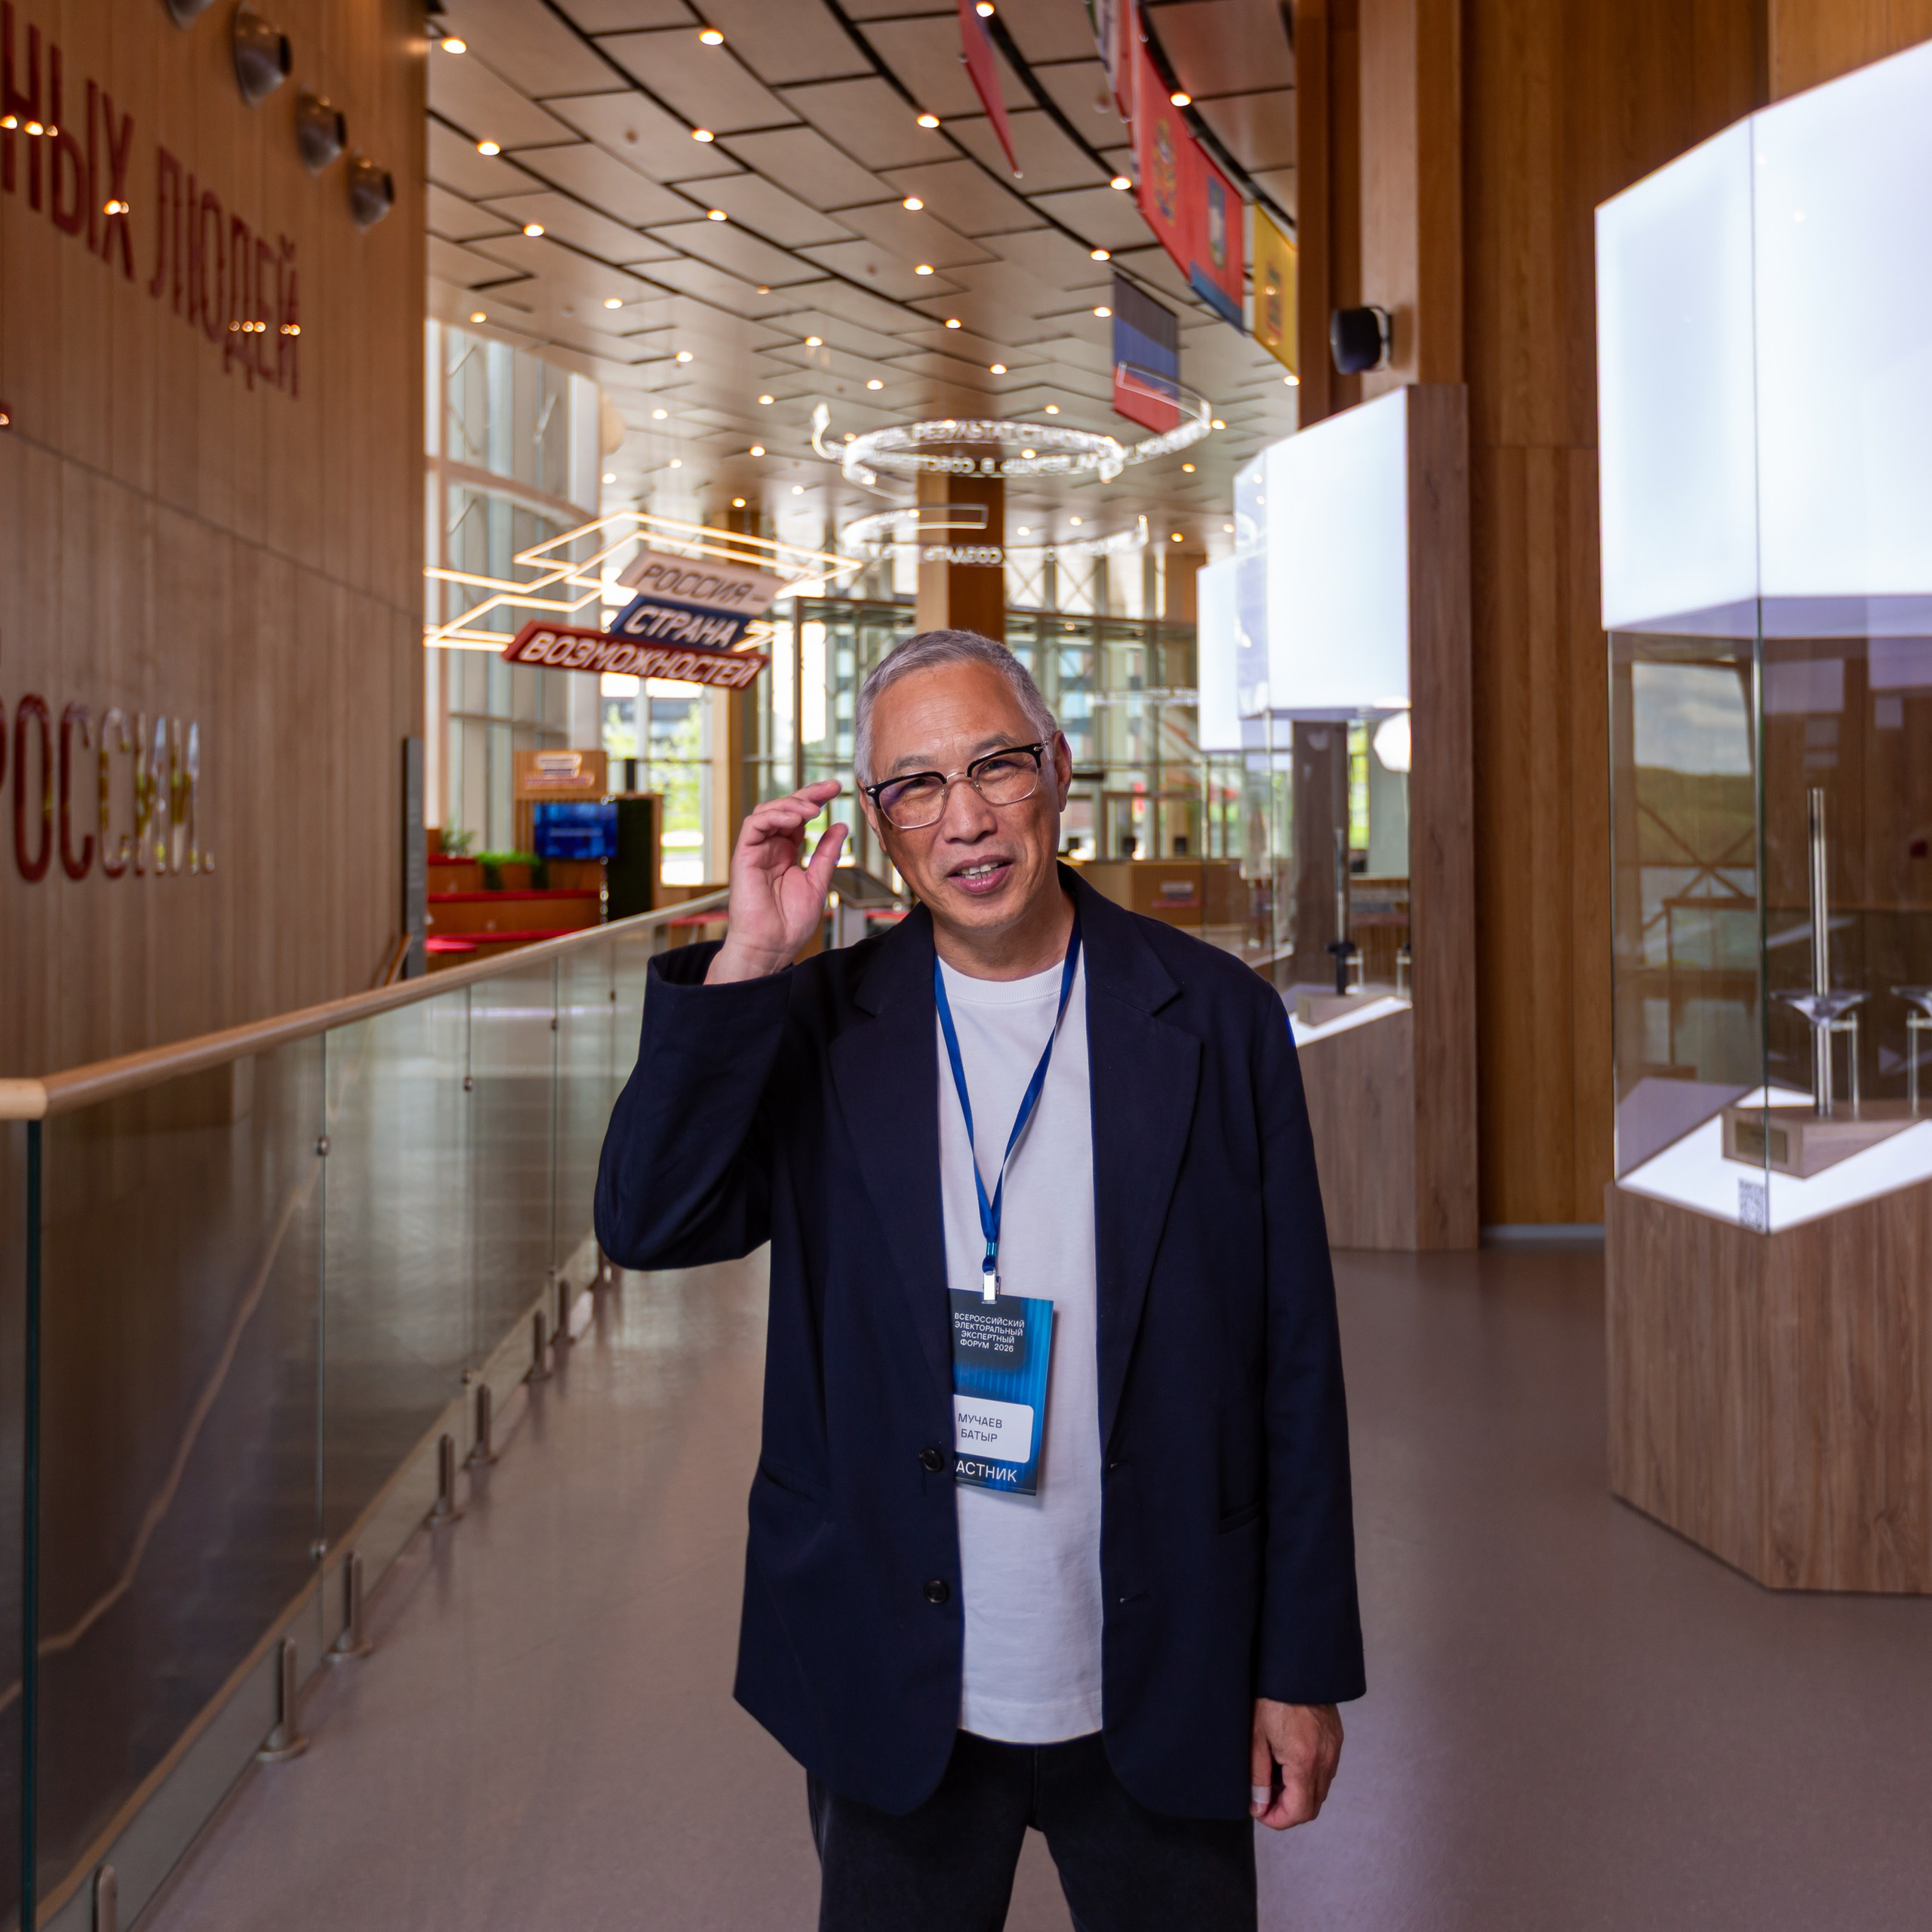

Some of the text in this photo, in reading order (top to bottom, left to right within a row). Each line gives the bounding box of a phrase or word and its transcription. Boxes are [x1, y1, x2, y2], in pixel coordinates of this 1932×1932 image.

[636, 563, 754, 605] РОССИЯ
[624, 605, 740, 648] СТРАНА
[518, 631, 762, 688] ВОЗМОЖНОСТЕЙ
[0, 693, 215, 883] ОССИИ.
[955, 1312, 1025, 1327] ВСЕРОССИЙСКИЙ
[955, 1321, 1023, 1336] ЭЛЕКТОРАЛЬНЫЙ
[961, 1331, 1014, 1343] ЭКСПЕРТНЫЙ
[960, 1339, 1014, 1352] ФОРУМ 2026
[958, 1413, 1002, 1429] МУЧАЕВ
[961, 1429, 998, 1442] БАТЫР
[954, 1460, 1017, 1482] АСТНИК
